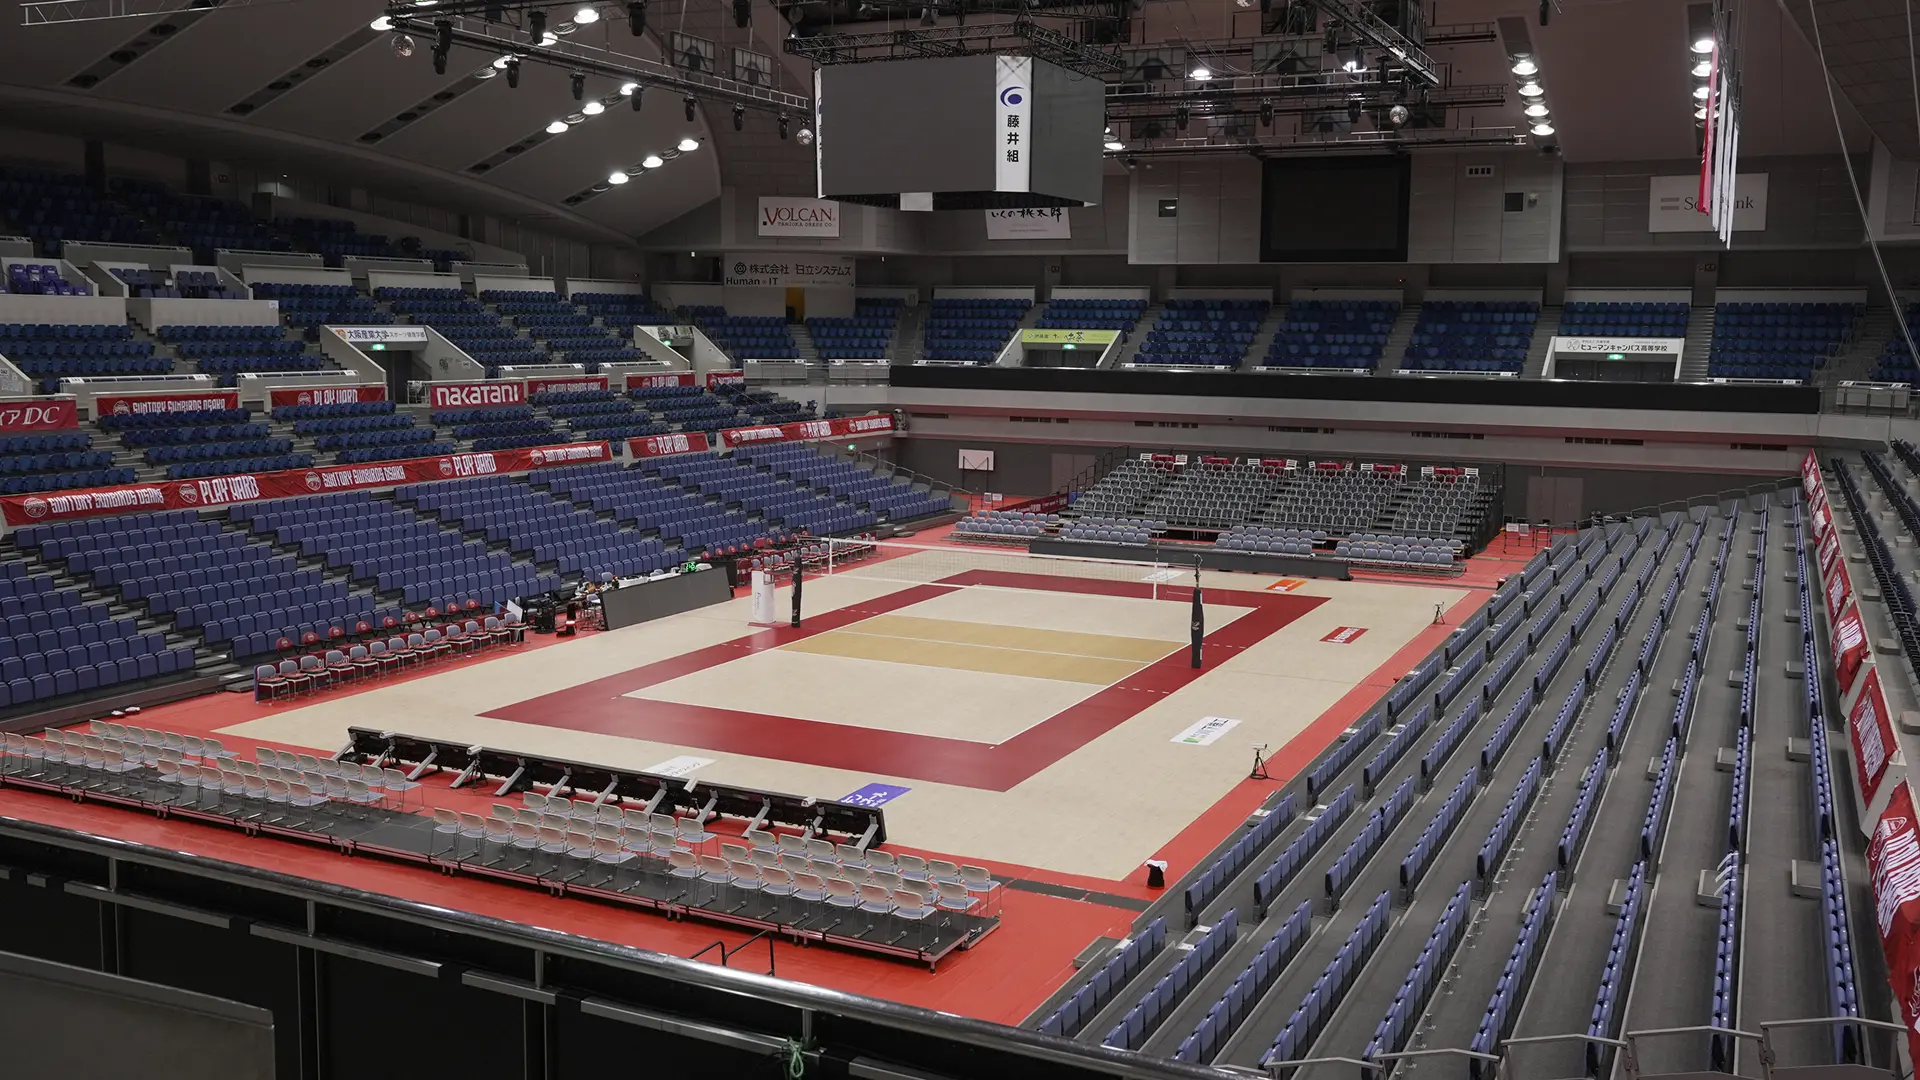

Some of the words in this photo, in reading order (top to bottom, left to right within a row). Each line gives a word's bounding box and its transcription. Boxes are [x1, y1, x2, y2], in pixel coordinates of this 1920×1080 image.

[1007, 114, 1020, 163] 藤井組
[764, 207, 832, 225] VOLCAN
[749, 263, 790, 275] 株式会社
[795, 263, 852, 276] 日立システムズ
[726, 277, 760, 286] Human
[768, 277, 779, 286] IT
[1580, 344, 1668, 352] ヒューマンキャンパス高等学校
[452, 454, 475, 476] PLAY
[322, 470, 353, 488] SUNTORY
[353, 467, 384, 484] SUNBIRDS
[383, 465, 406, 481] OSAKA
[47, 494, 93, 514] SUNTORY
[91, 489, 138, 508] SUNBIRDS
[198, 479, 230, 504] PLAY
